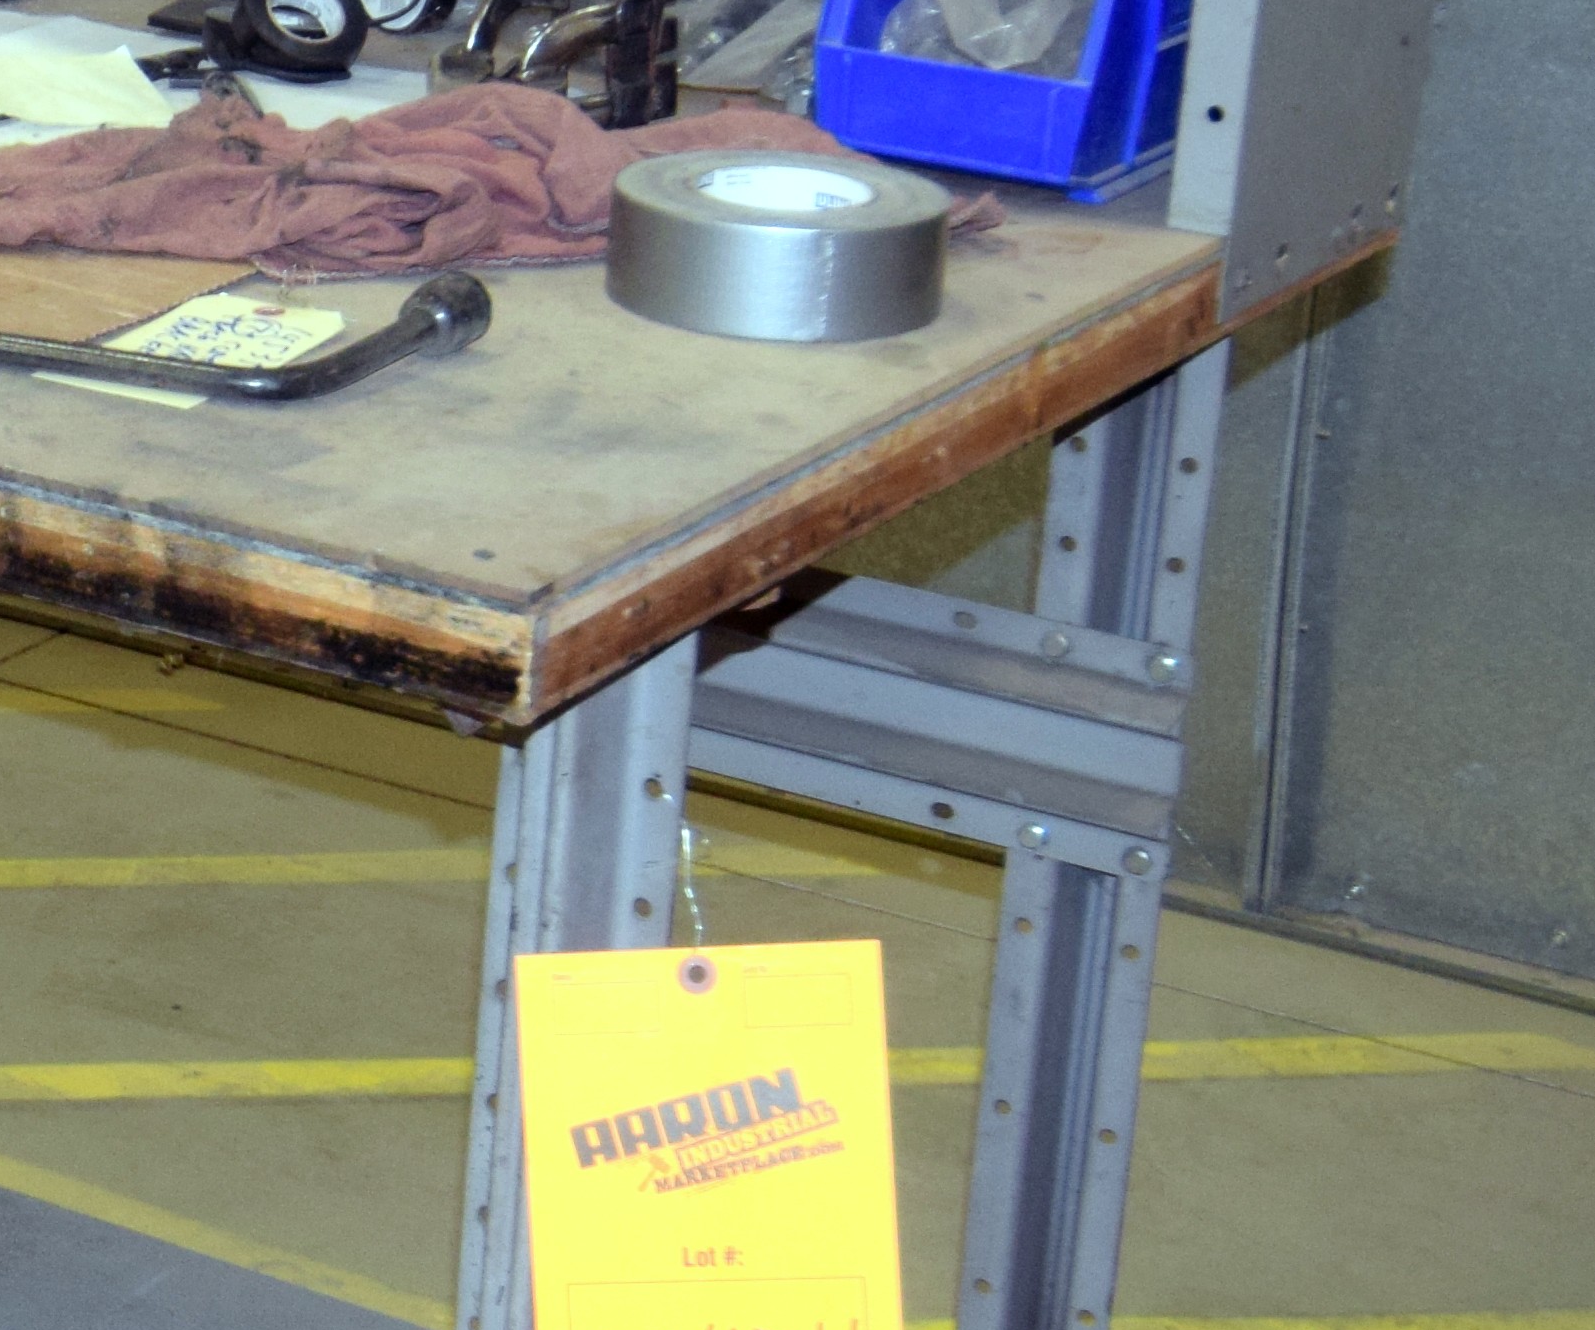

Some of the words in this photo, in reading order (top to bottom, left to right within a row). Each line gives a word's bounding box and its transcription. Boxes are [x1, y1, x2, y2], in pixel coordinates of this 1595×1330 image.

[570, 1067, 803, 1169] AARON
[677, 1100, 839, 1170] INDUSTRIAL
[682, 1247, 717, 1267] Lot
